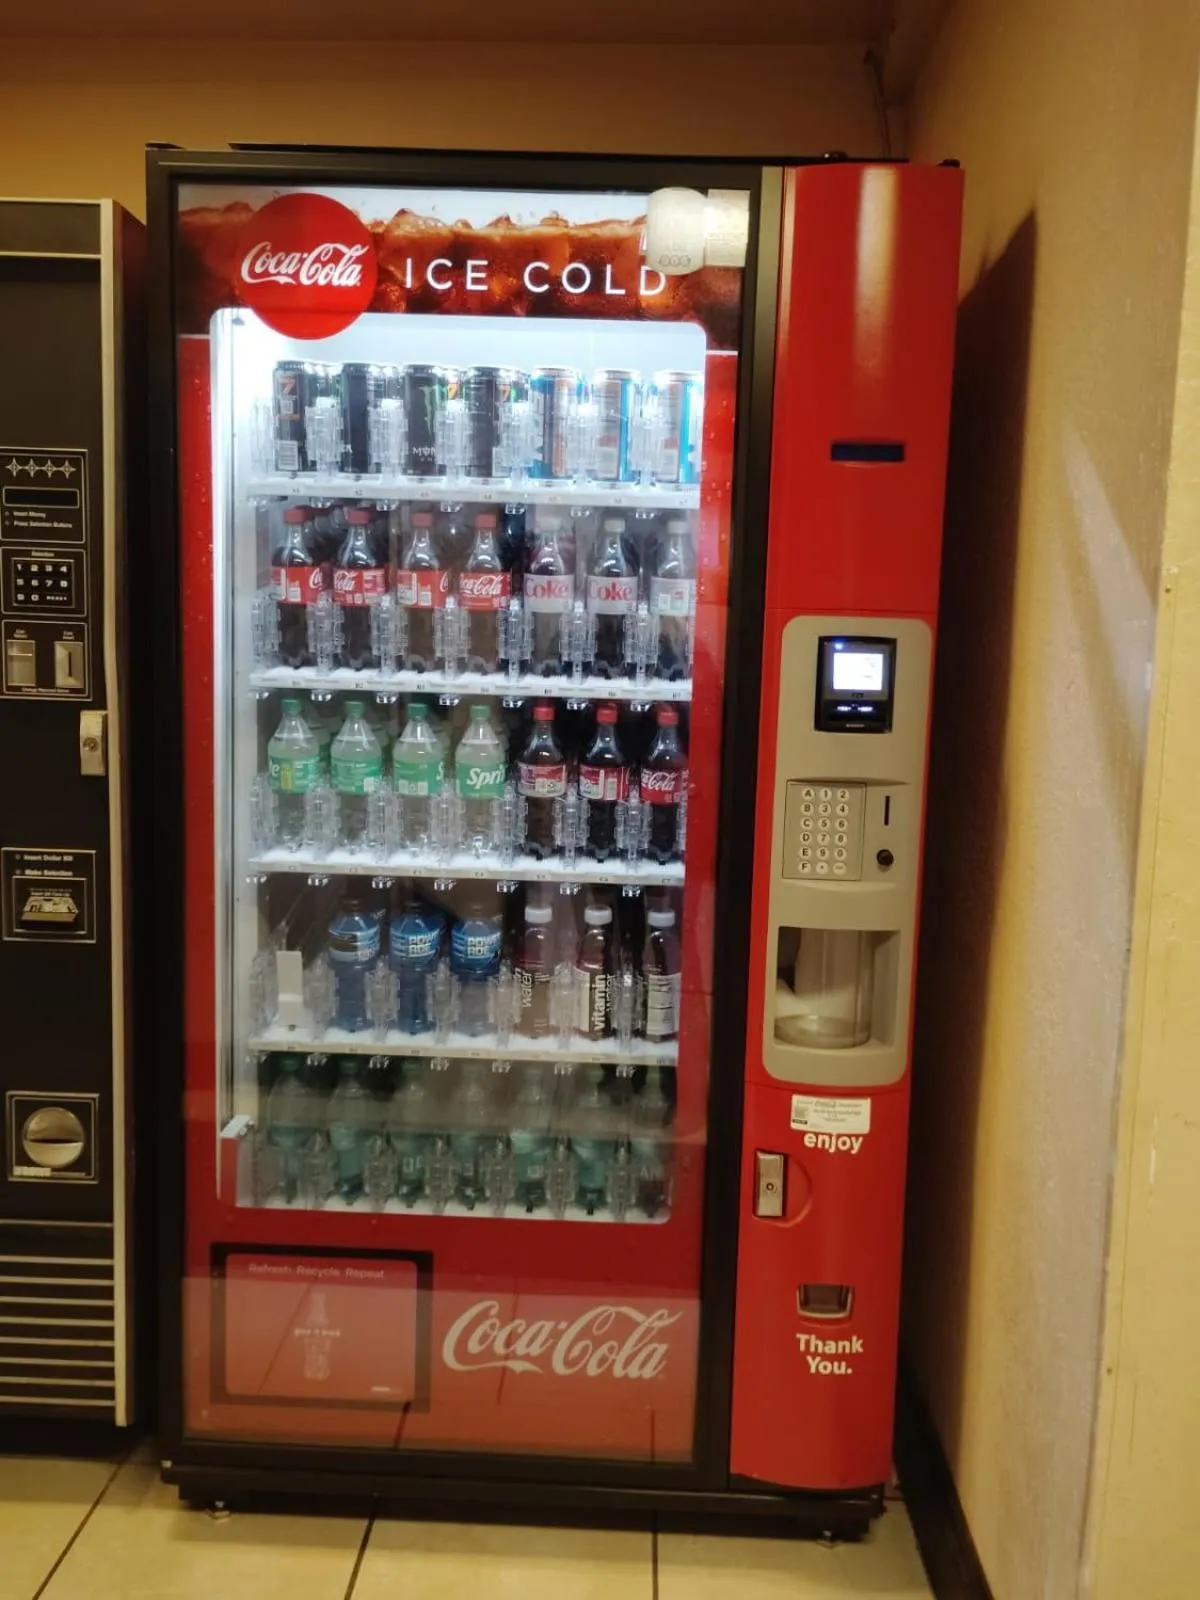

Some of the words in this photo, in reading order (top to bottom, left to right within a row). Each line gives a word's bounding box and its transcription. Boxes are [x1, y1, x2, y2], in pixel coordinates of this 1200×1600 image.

[241, 242, 369, 287] Coca-Cola
[404, 257, 488, 291] ICE
[523, 261, 666, 296] COLD
[803, 819, 810, 827] C
[838, 820, 845, 828] 6
[802, 833, 810, 841] D
[802, 848, 808, 856] E
[592, 974, 606, 1031] vitamin
[803, 1132, 864, 1154] enjoy
[442, 1300, 684, 1379] Coca-Cola
[795, 1333, 864, 1354] Thank
[806, 1355, 853, 1375] You.
